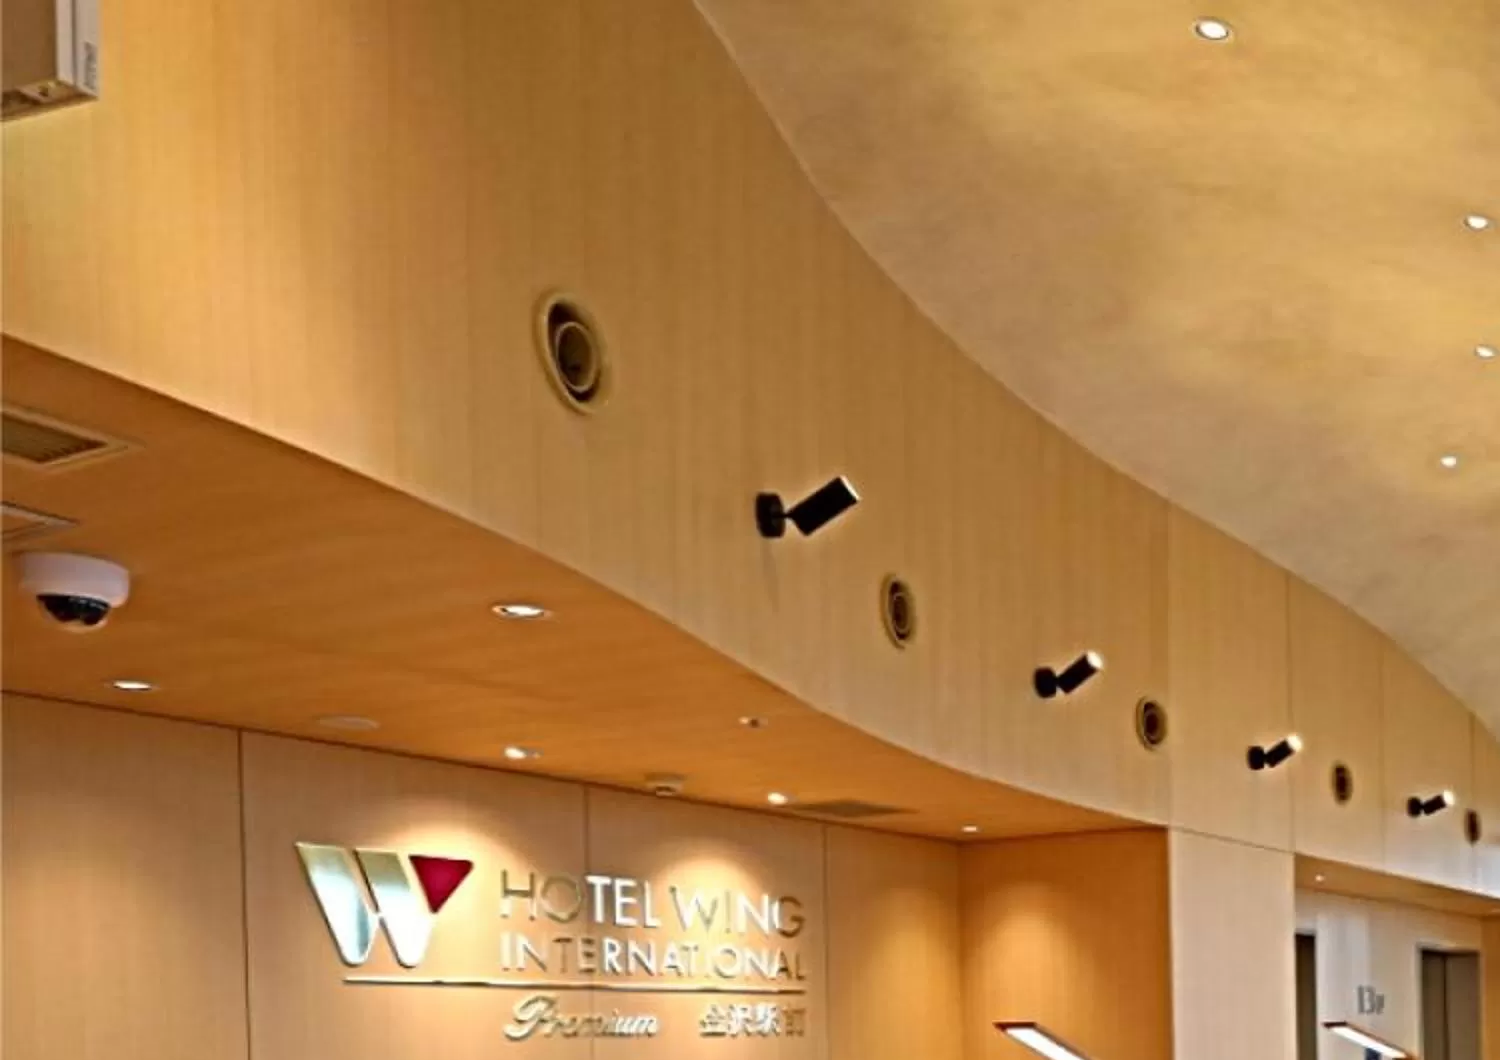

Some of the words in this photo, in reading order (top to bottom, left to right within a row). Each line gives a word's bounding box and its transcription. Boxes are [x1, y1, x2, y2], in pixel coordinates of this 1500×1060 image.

[499, 869, 664, 928] HOTEL
[668, 885, 806, 938] WING
[499, 930, 806, 981] INTERNATIONAL
[503, 994, 658, 1040] Premium
